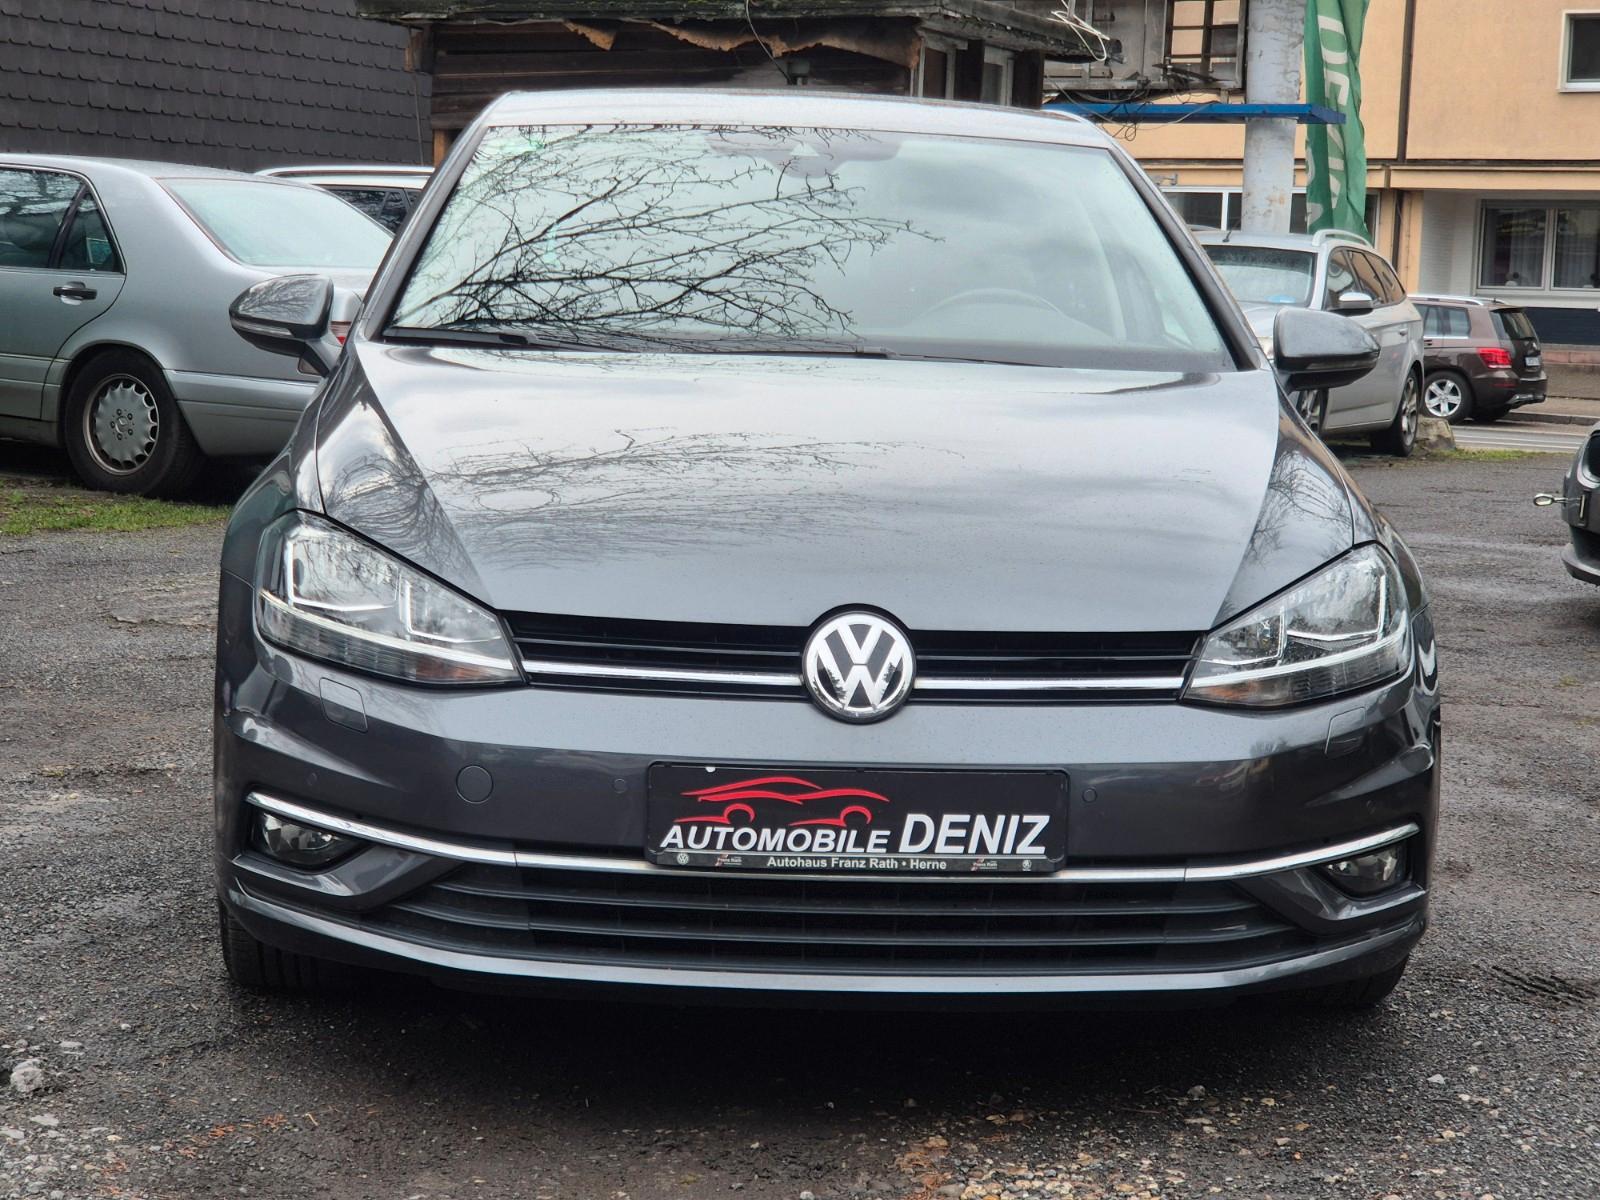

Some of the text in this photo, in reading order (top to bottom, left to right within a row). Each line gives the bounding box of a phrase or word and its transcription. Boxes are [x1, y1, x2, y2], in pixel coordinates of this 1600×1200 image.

[806, 612, 914, 718] VW
[660, 813, 1050, 855] AUTOMOBILE DENIZ
[767, 856, 947, 870] Autohaus Franz Rath Herne
